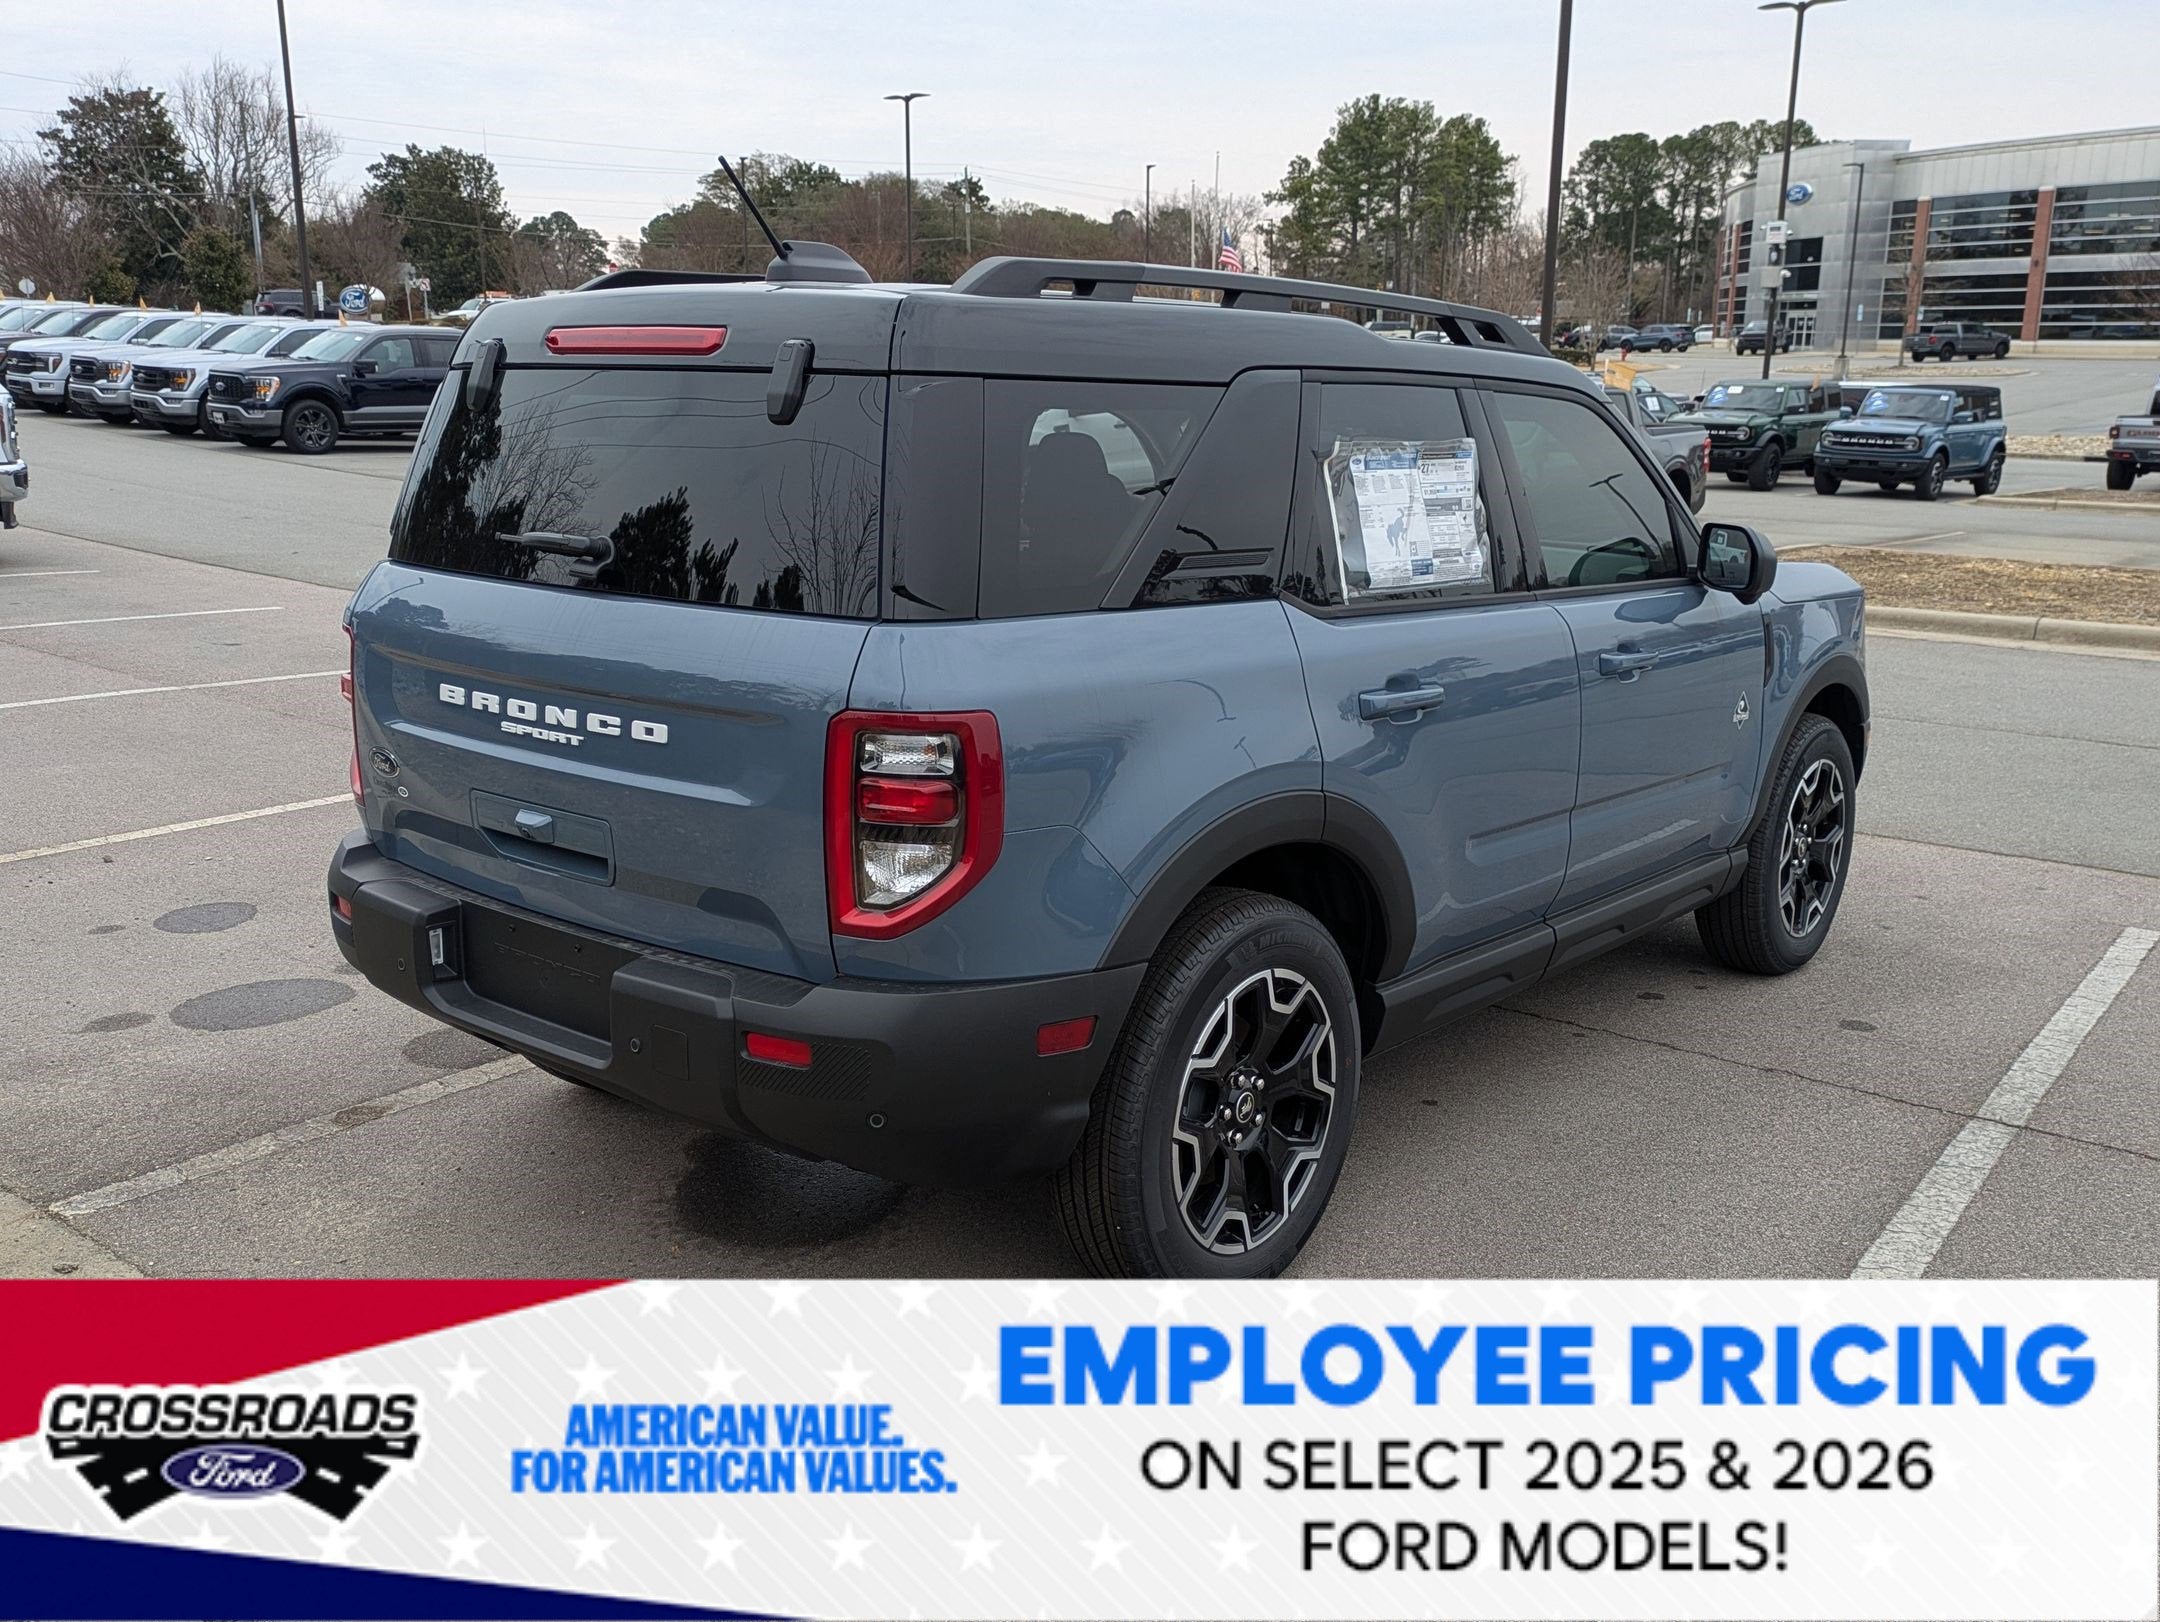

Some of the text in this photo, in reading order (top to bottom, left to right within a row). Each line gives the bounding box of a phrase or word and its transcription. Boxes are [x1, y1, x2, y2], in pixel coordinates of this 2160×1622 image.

[345, 291, 366, 308] Ford
[440, 683, 668, 744] BRONCO
[500, 720, 584, 746] SPORT
